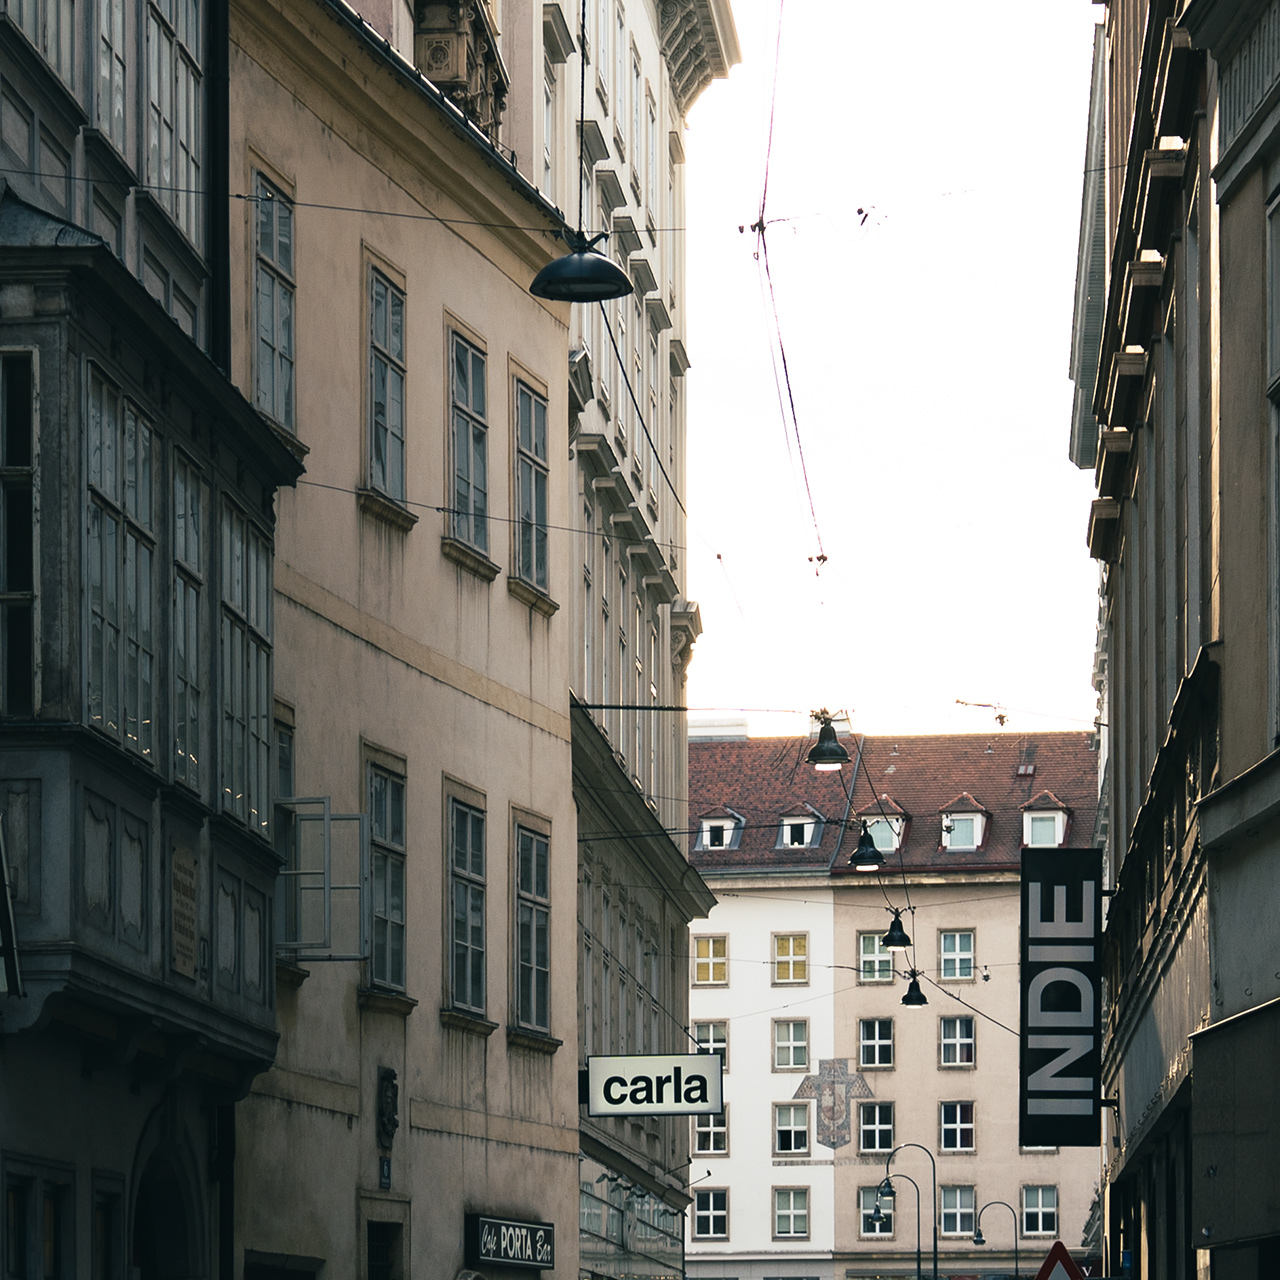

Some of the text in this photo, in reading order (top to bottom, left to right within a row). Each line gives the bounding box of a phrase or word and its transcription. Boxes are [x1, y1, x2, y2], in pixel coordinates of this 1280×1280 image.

[1027, 880, 1095, 1116] INDIE
[602, 1066, 709, 1105] carla
[500, 1225, 533, 1260] PORTA
[536, 1229, 551, 1262] Bar
